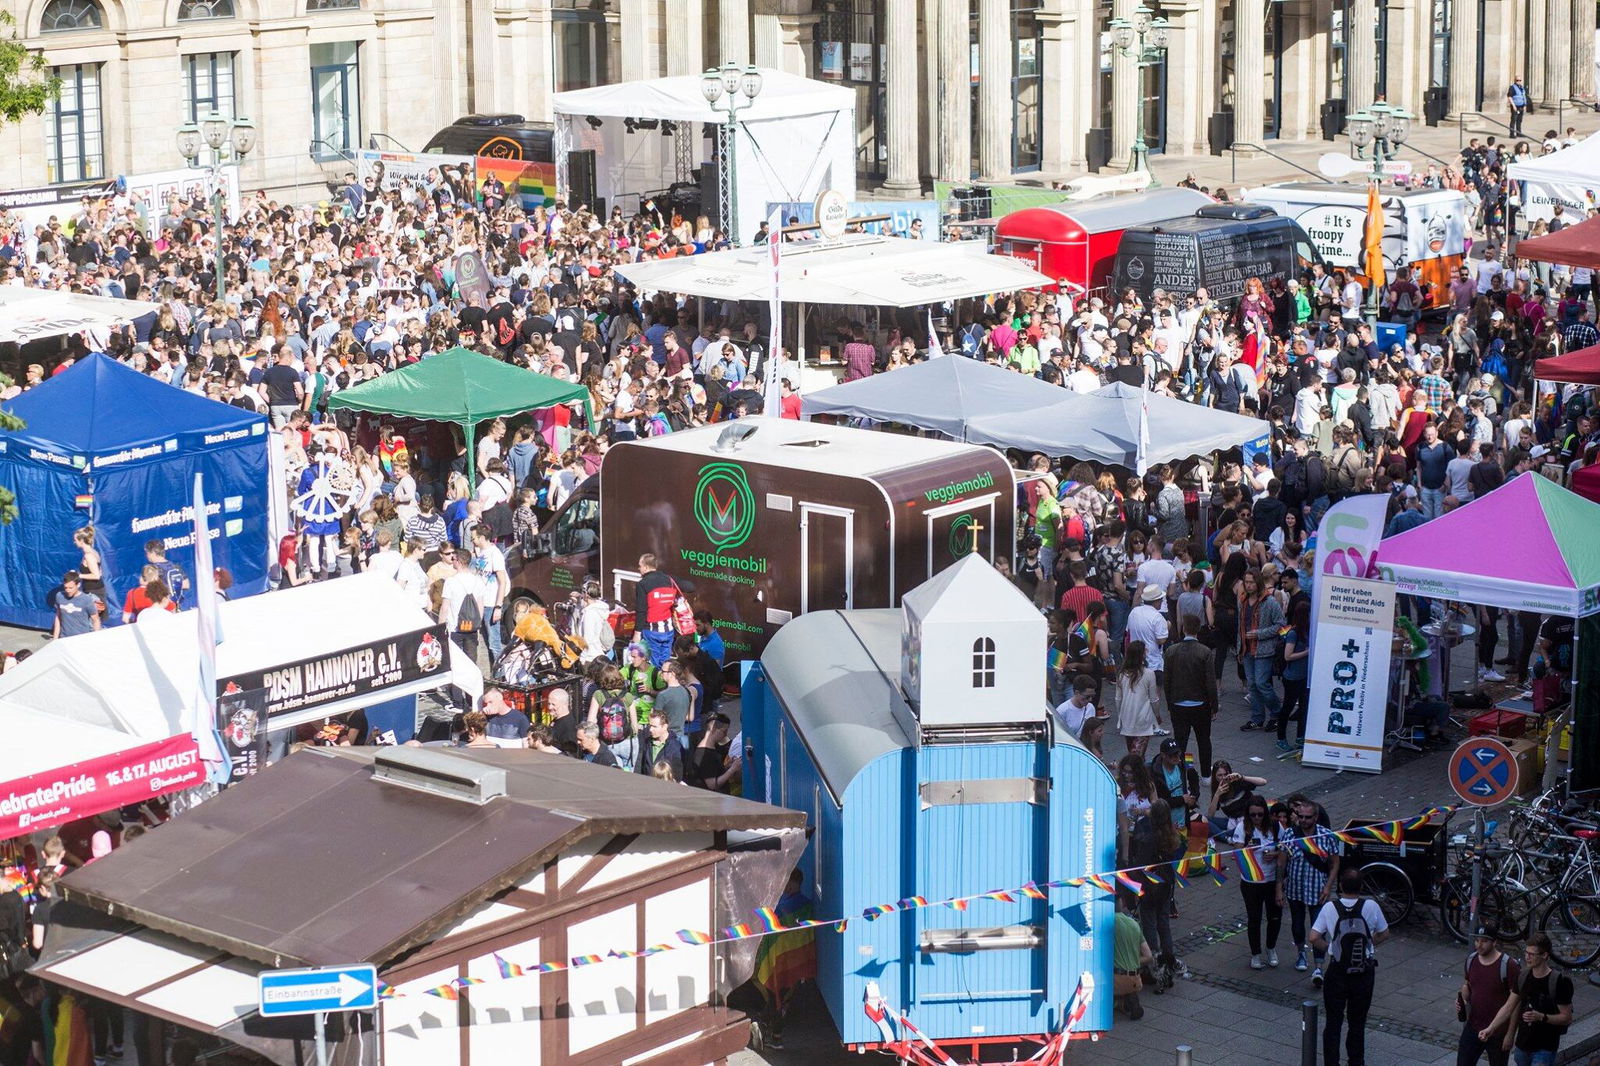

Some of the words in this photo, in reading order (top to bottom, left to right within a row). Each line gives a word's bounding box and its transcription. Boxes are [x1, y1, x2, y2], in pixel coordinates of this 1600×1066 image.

[1308, 227, 1344, 243] froopy
[1155, 243, 1189, 251] DELUXE
[1223, 262, 1272, 281] WUNDERBAR
[924, 471, 994, 503] veggiemobil
[164, 534, 191, 551] Neue
[680, 548, 767, 574] veggiemobil
[689, 567, 727, 581] homemade
[728, 575, 756, 587] cooking
[1331, 585, 1351, 595] Unser
[1352, 587, 1373, 597] Leben
[1329, 602, 1342, 611] frei
[1342, 604, 1375, 615] gestalten
[1330, 594, 1342, 602] mit
[1343, 595, 1356, 603] HIV
[1356, 597, 1370, 605] und
[1370, 598, 1386, 608] Aids
[305, 648, 375, 693] HANNOVER
[378, 642, 402, 674] e.V.
[1360, 640, 1370, 683] Niedersachsen
[384, 670, 403, 686] 2000
[1358, 690, 1366, 709] Positiv
[1356, 710, 1364, 736] Netzwerk
[148, 749, 198, 776] AUGUST
[267, 985, 343, 1000] Einbahnstraße
